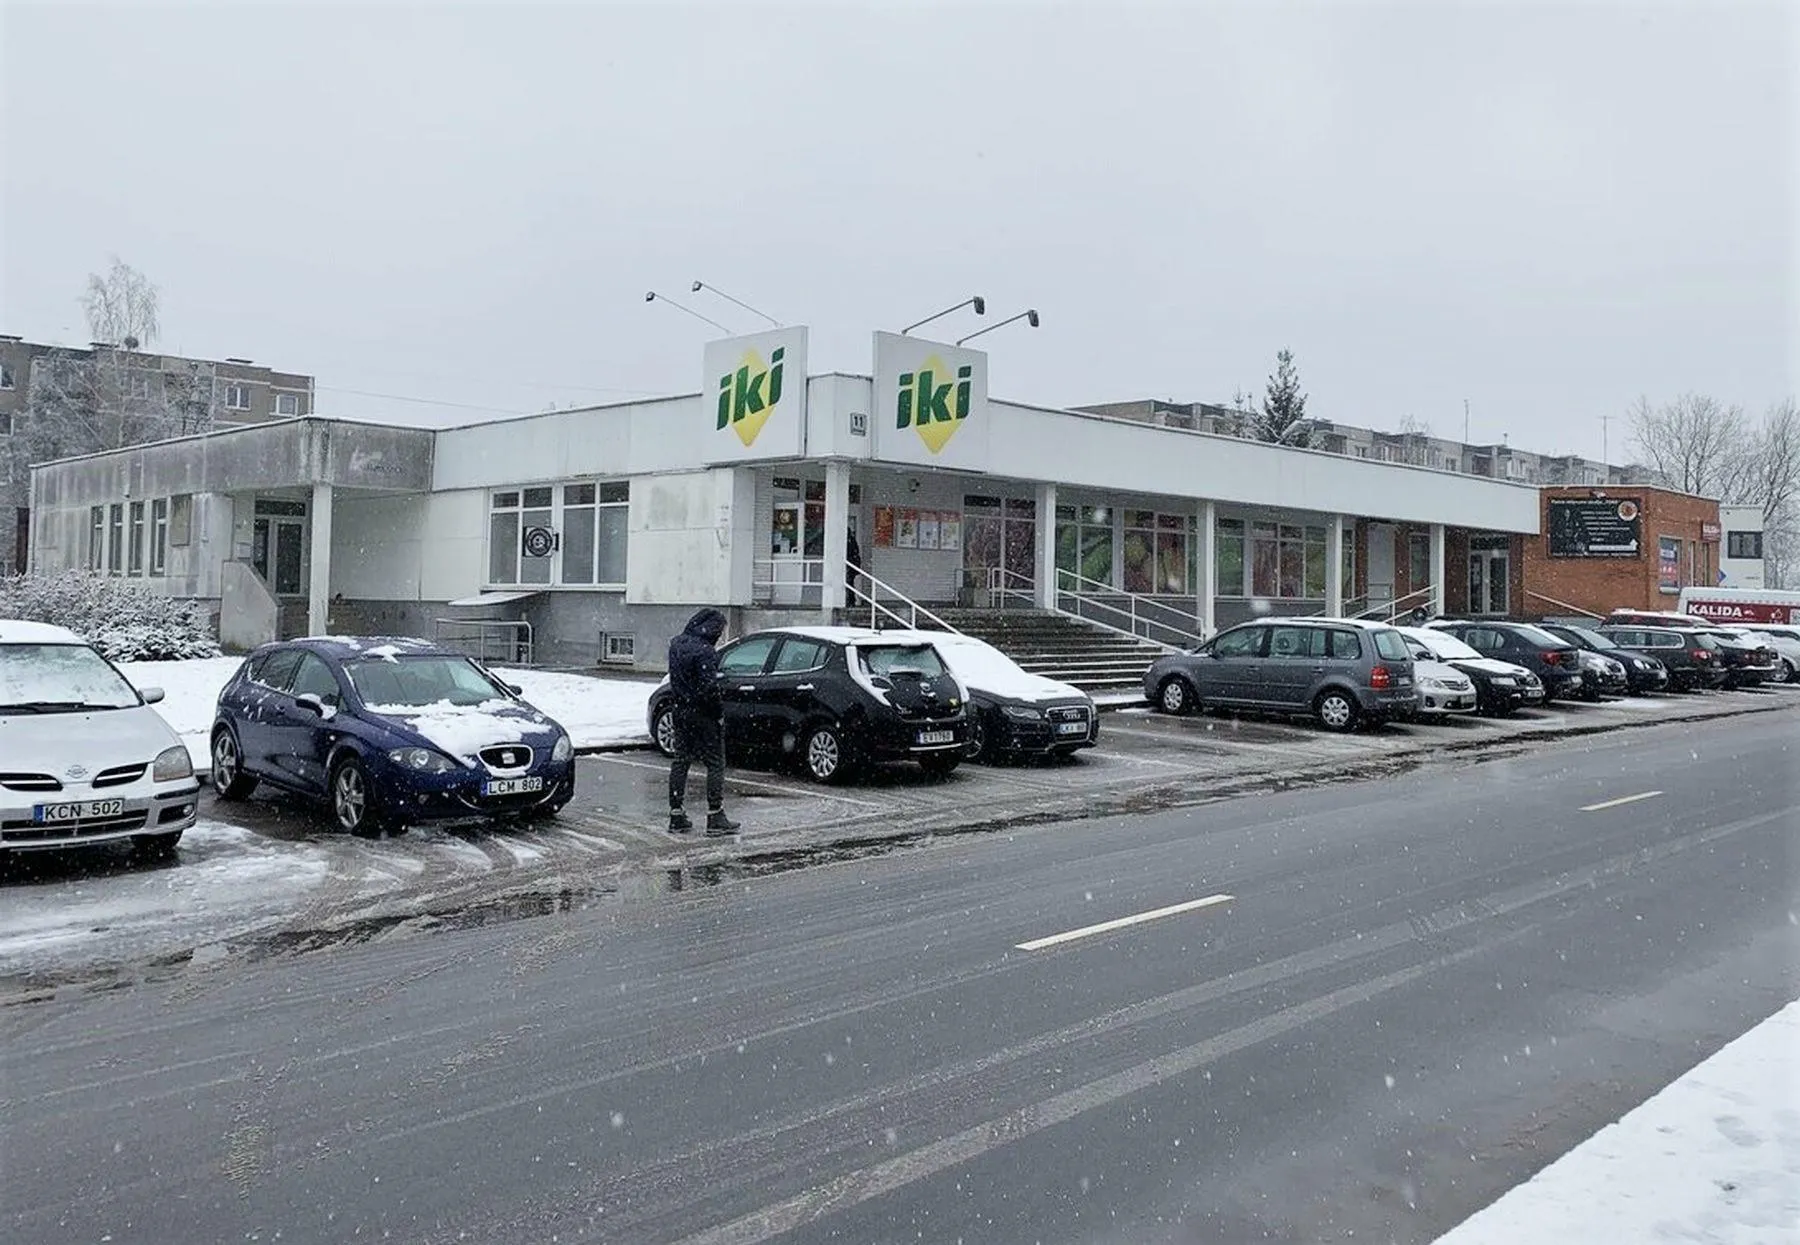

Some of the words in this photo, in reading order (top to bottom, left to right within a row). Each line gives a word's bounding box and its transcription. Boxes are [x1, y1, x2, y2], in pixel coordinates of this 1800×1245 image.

[716, 347, 785, 431] iki
[896, 366, 972, 430] iki
[853, 416, 863, 428] 11
[1688, 604, 1743, 617] KALIDA
[489, 781, 515, 794] LCM
[522, 778, 541, 791] 802
[45, 804, 82, 820] KCN
[92, 801, 120, 816] 502
